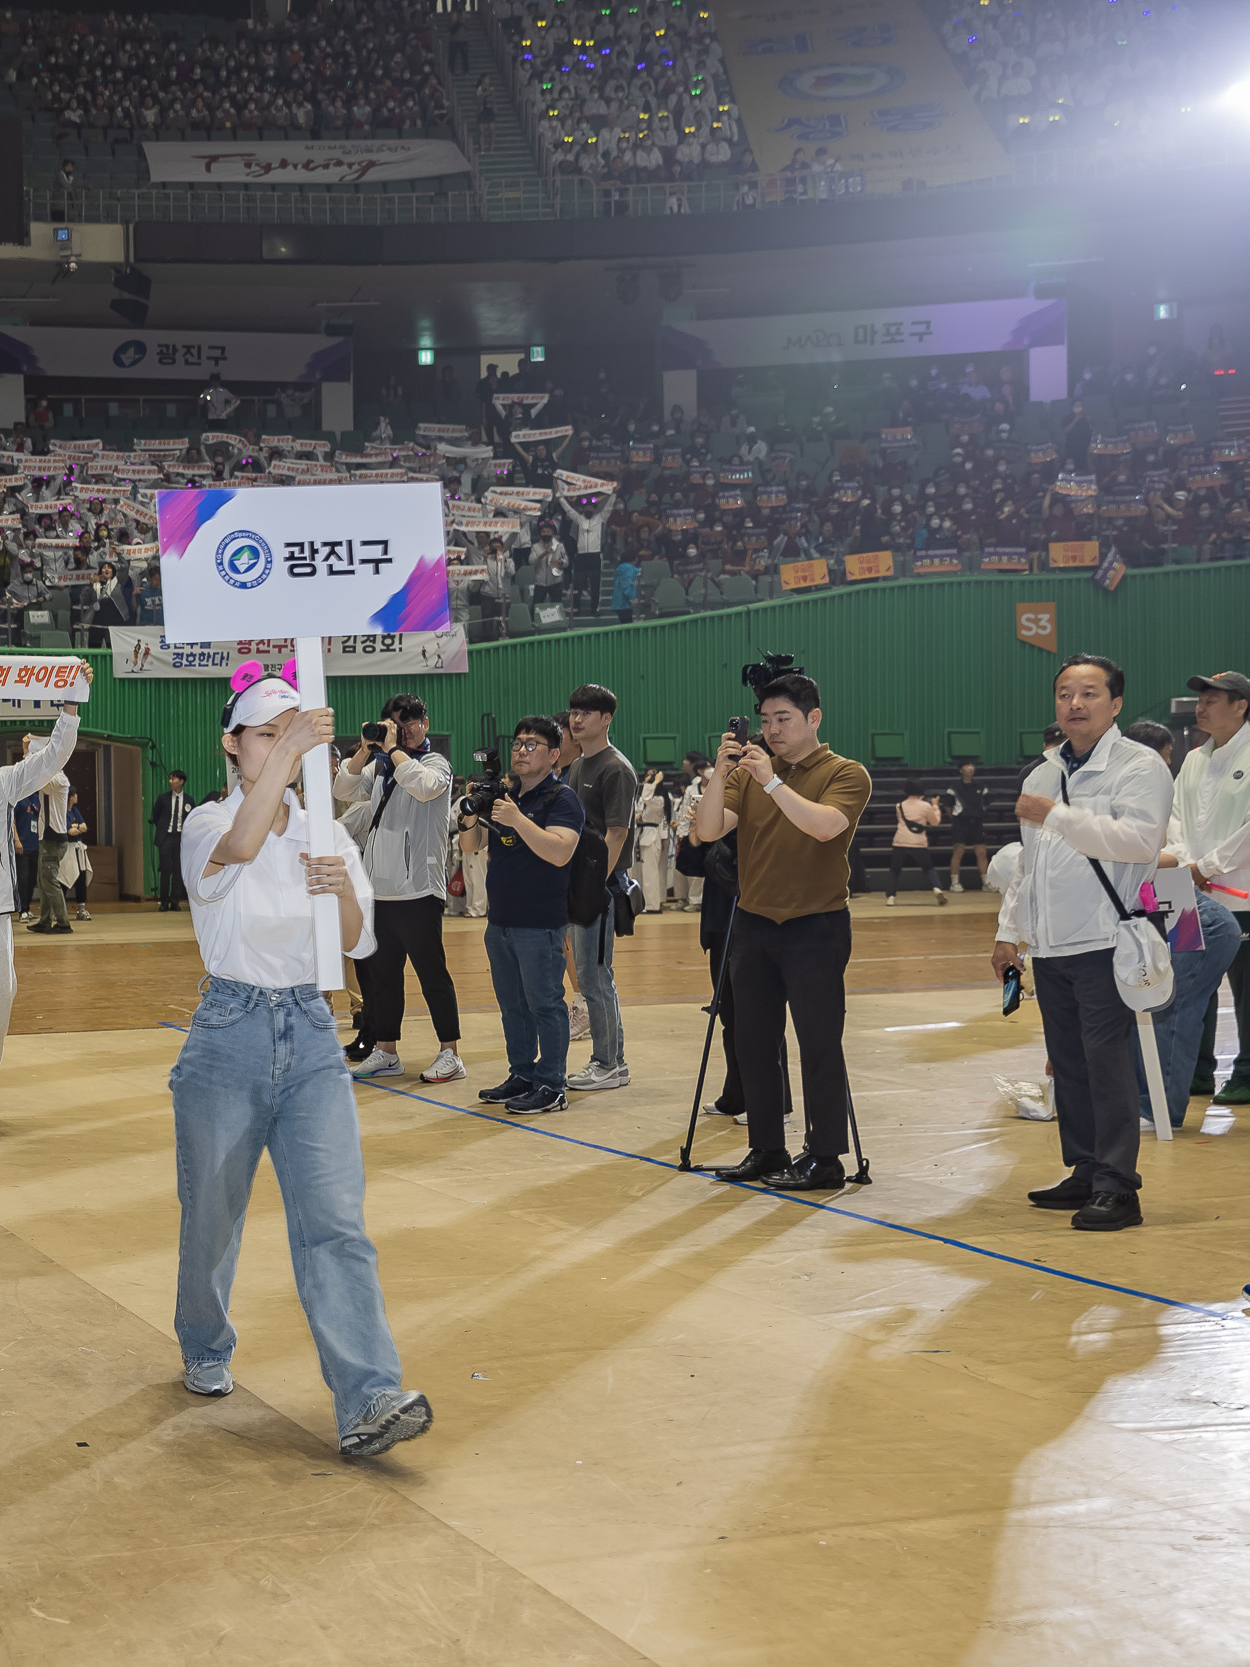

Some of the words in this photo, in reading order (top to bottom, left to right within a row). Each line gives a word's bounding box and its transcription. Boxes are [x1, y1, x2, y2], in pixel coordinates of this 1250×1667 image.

[853, 320, 933, 346] 마포구
[156, 343, 228, 368] 광진구
[283, 539, 393, 578] 광진구
[1020, 613, 1052, 636] S3
[340, 634, 403, 655] 김경호!
[172, 651, 231, 669] 경호한다!
[14, 665, 82, 689] 화이팅!
